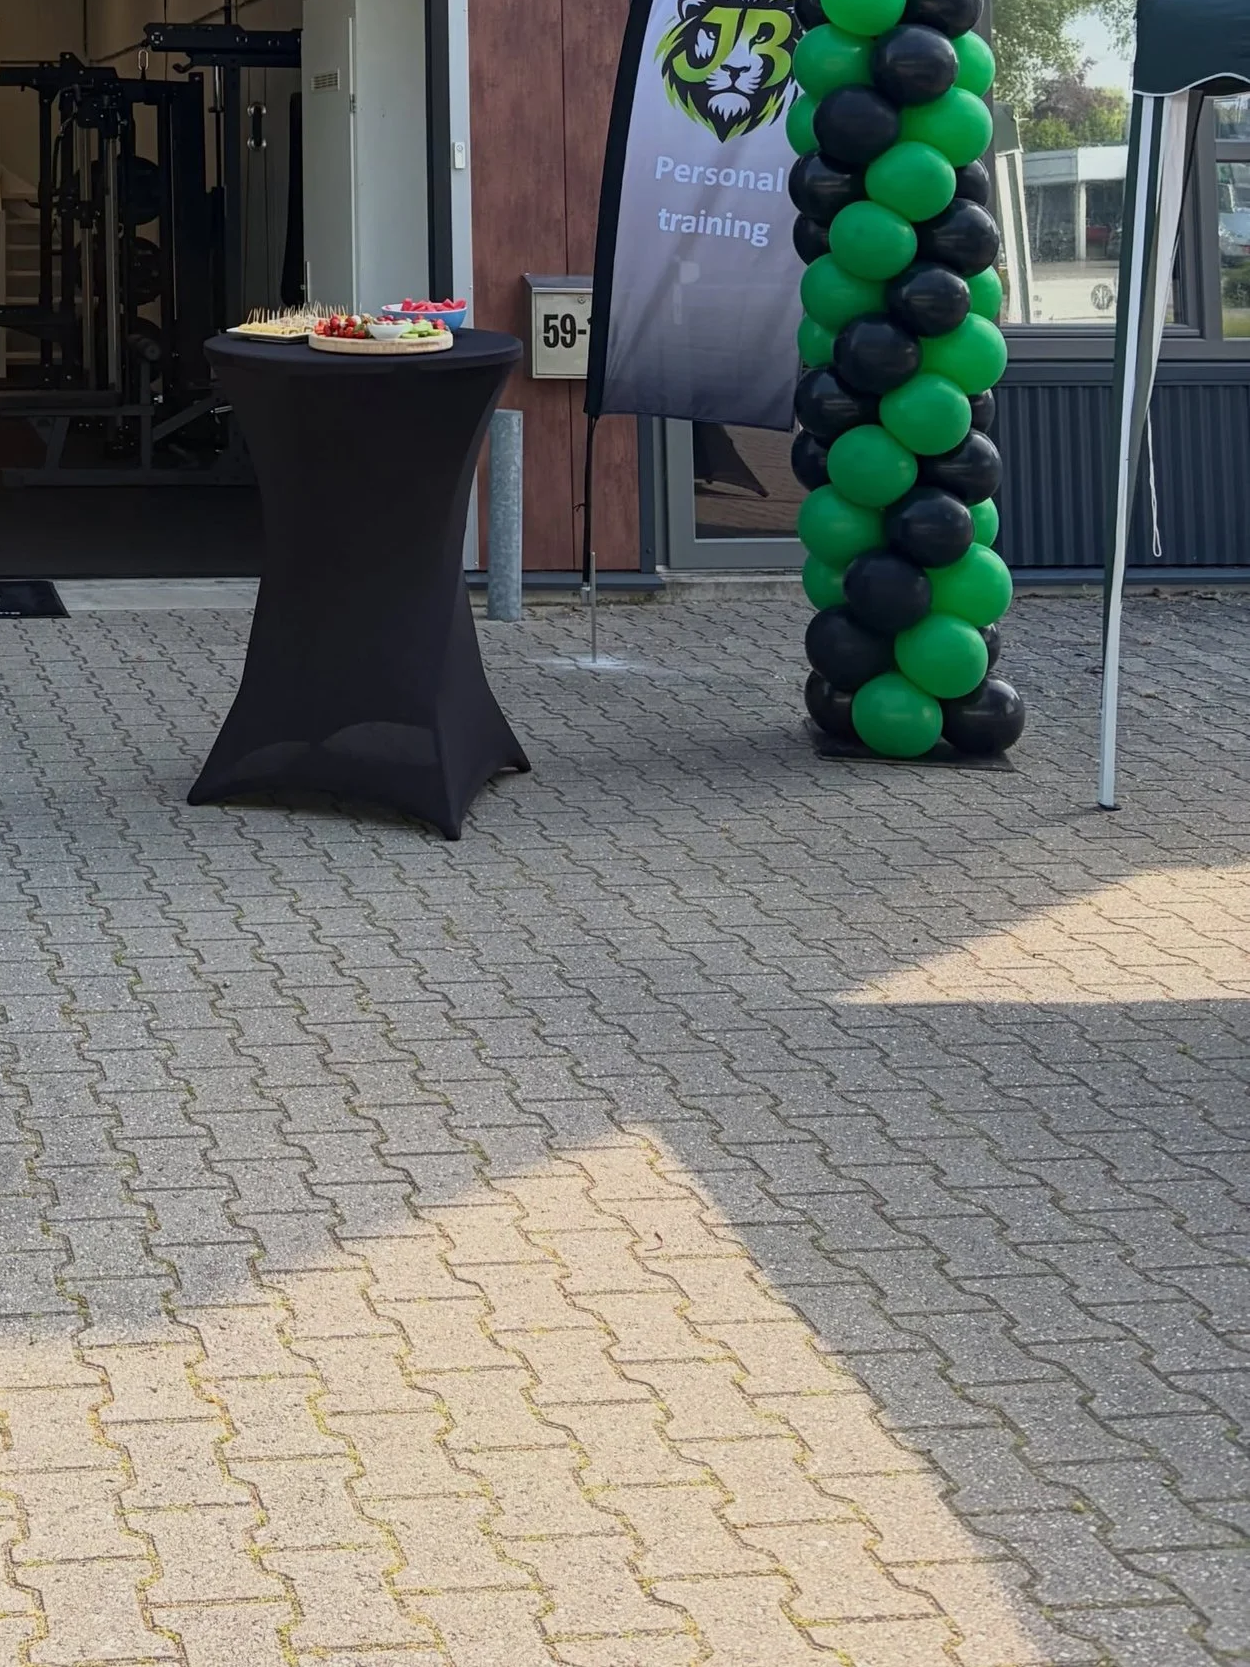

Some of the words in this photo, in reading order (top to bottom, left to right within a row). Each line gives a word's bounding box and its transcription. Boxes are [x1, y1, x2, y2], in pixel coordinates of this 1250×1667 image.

[654, 155, 784, 194] Personal
[658, 207, 771, 248] training
[543, 313, 592, 349] 59-
